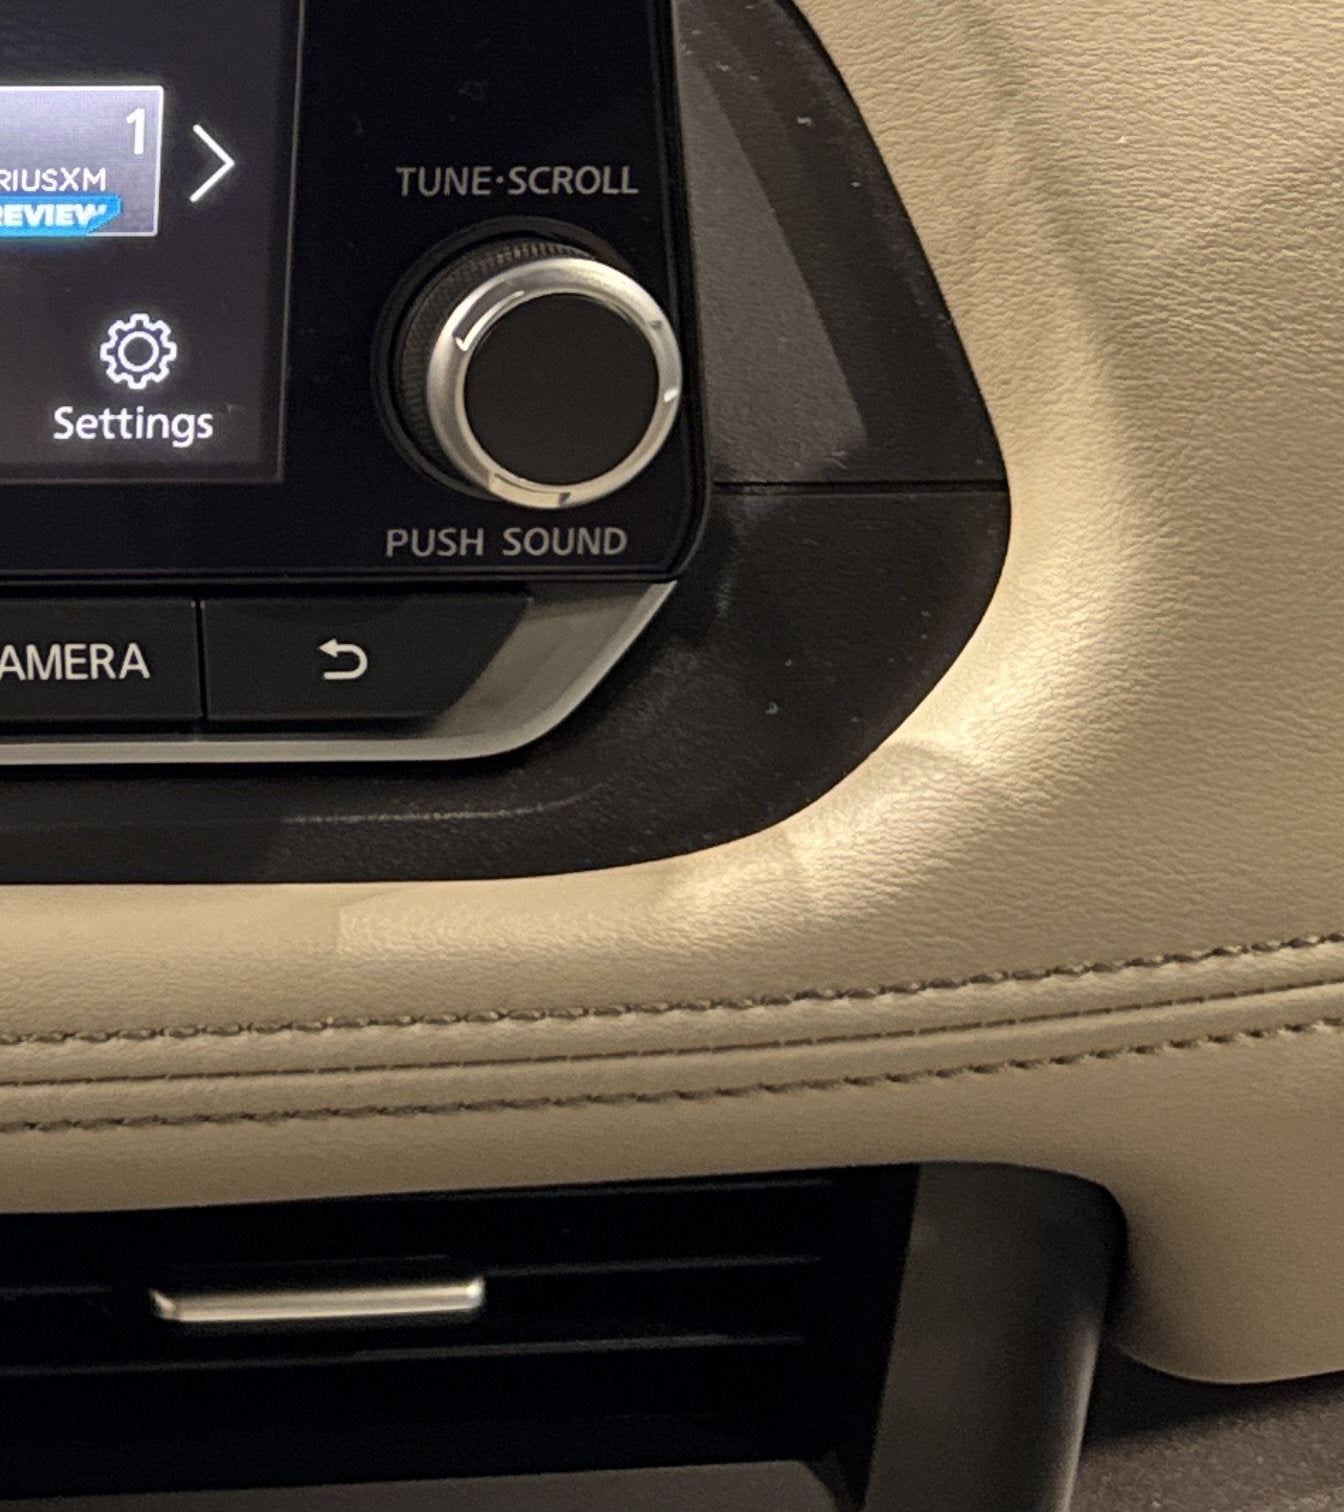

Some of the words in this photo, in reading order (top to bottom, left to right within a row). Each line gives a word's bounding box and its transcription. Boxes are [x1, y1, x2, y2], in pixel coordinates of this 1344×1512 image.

[125, 107, 147, 156] 1
[53, 405, 214, 448] Settings
[386, 527, 484, 557] PUSH
[502, 527, 627, 556] SOUND
